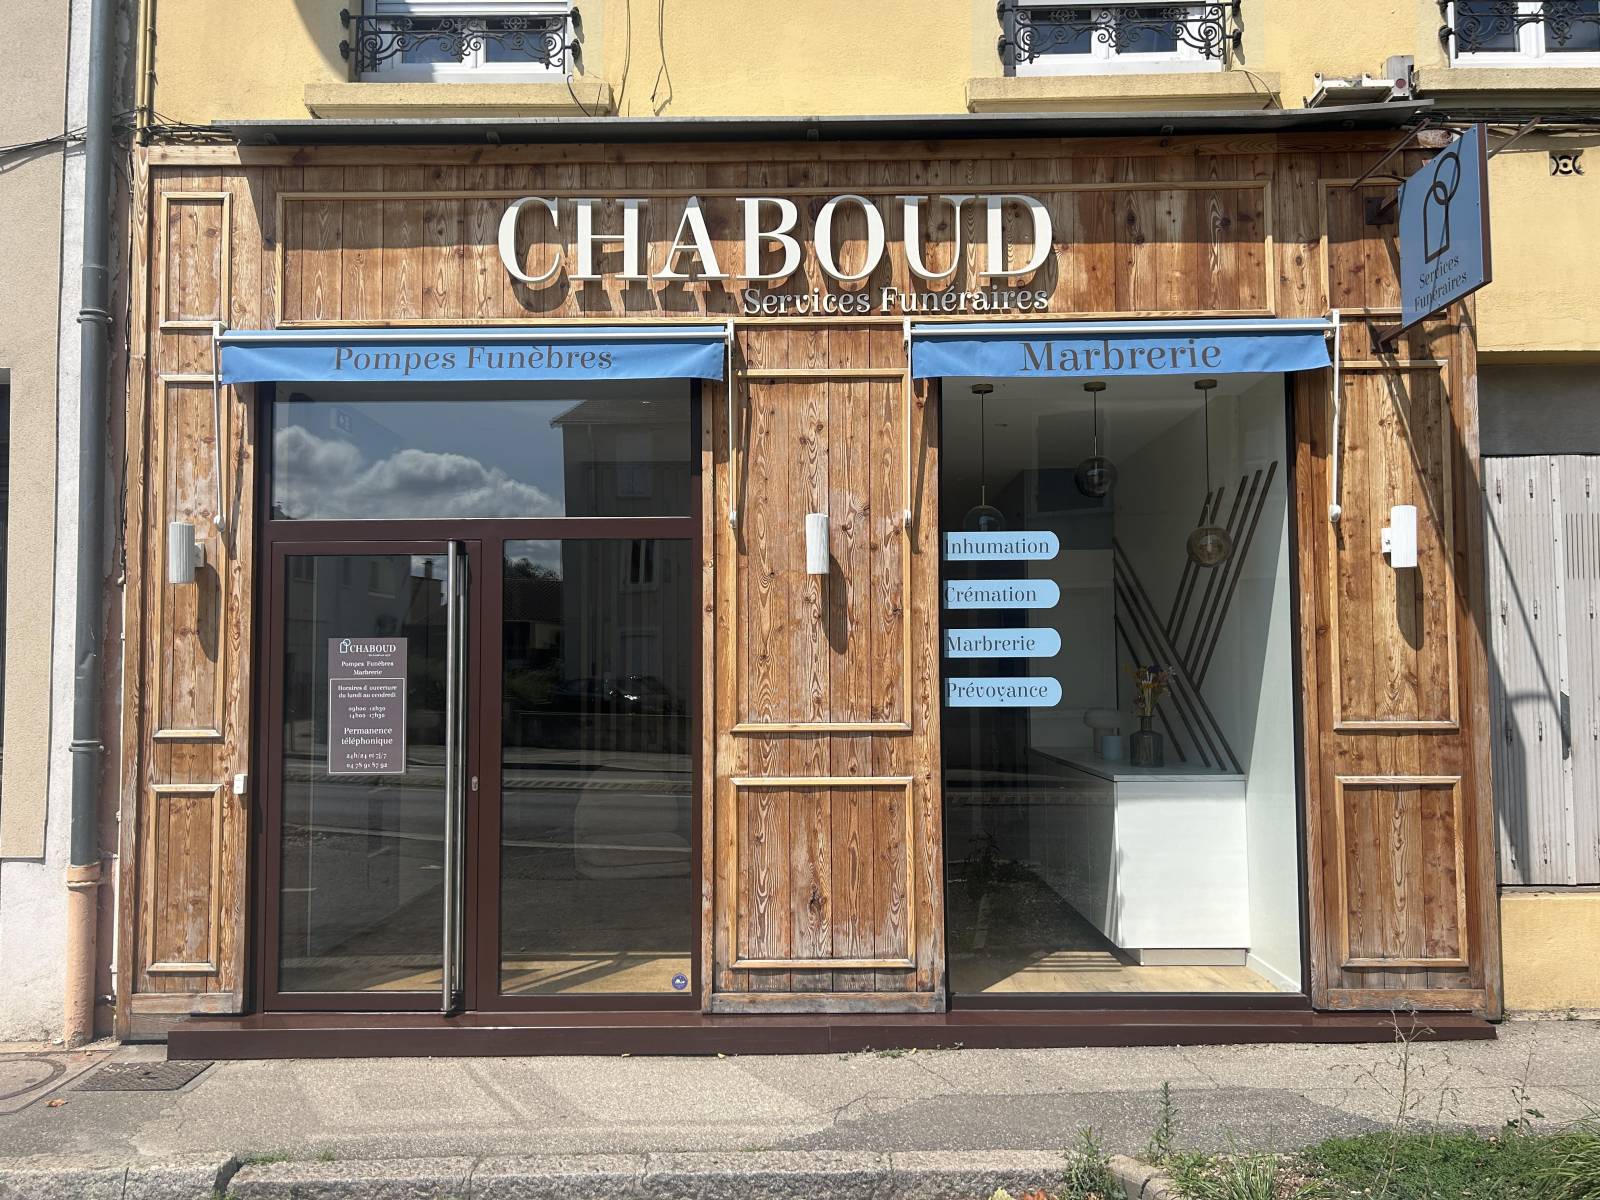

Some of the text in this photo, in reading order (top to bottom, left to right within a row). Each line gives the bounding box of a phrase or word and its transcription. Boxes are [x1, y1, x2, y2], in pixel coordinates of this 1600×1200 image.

[498, 195, 1053, 283] CHABOUD
[1419, 255, 1460, 289] Services
[743, 284, 1050, 315] Services Funéraires
[335, 345, 614, 376] Pompes Funèbres
[1019, 337, 1223, 372] Marbrerie
[945, 538, 1051, 555] Inhumation
[944, 586, 1037, 603] Crémation
[349, 644, 397, 653] CHABOUD
[945, 635, 1036, 652] Marbrerie
[341, 660, 365, 668] Pompes
[946, 682, 1048, 702] Prévoyance
[344, 727, 393, 735] Permanence
[341, 736, 393, 746] téléphonique
